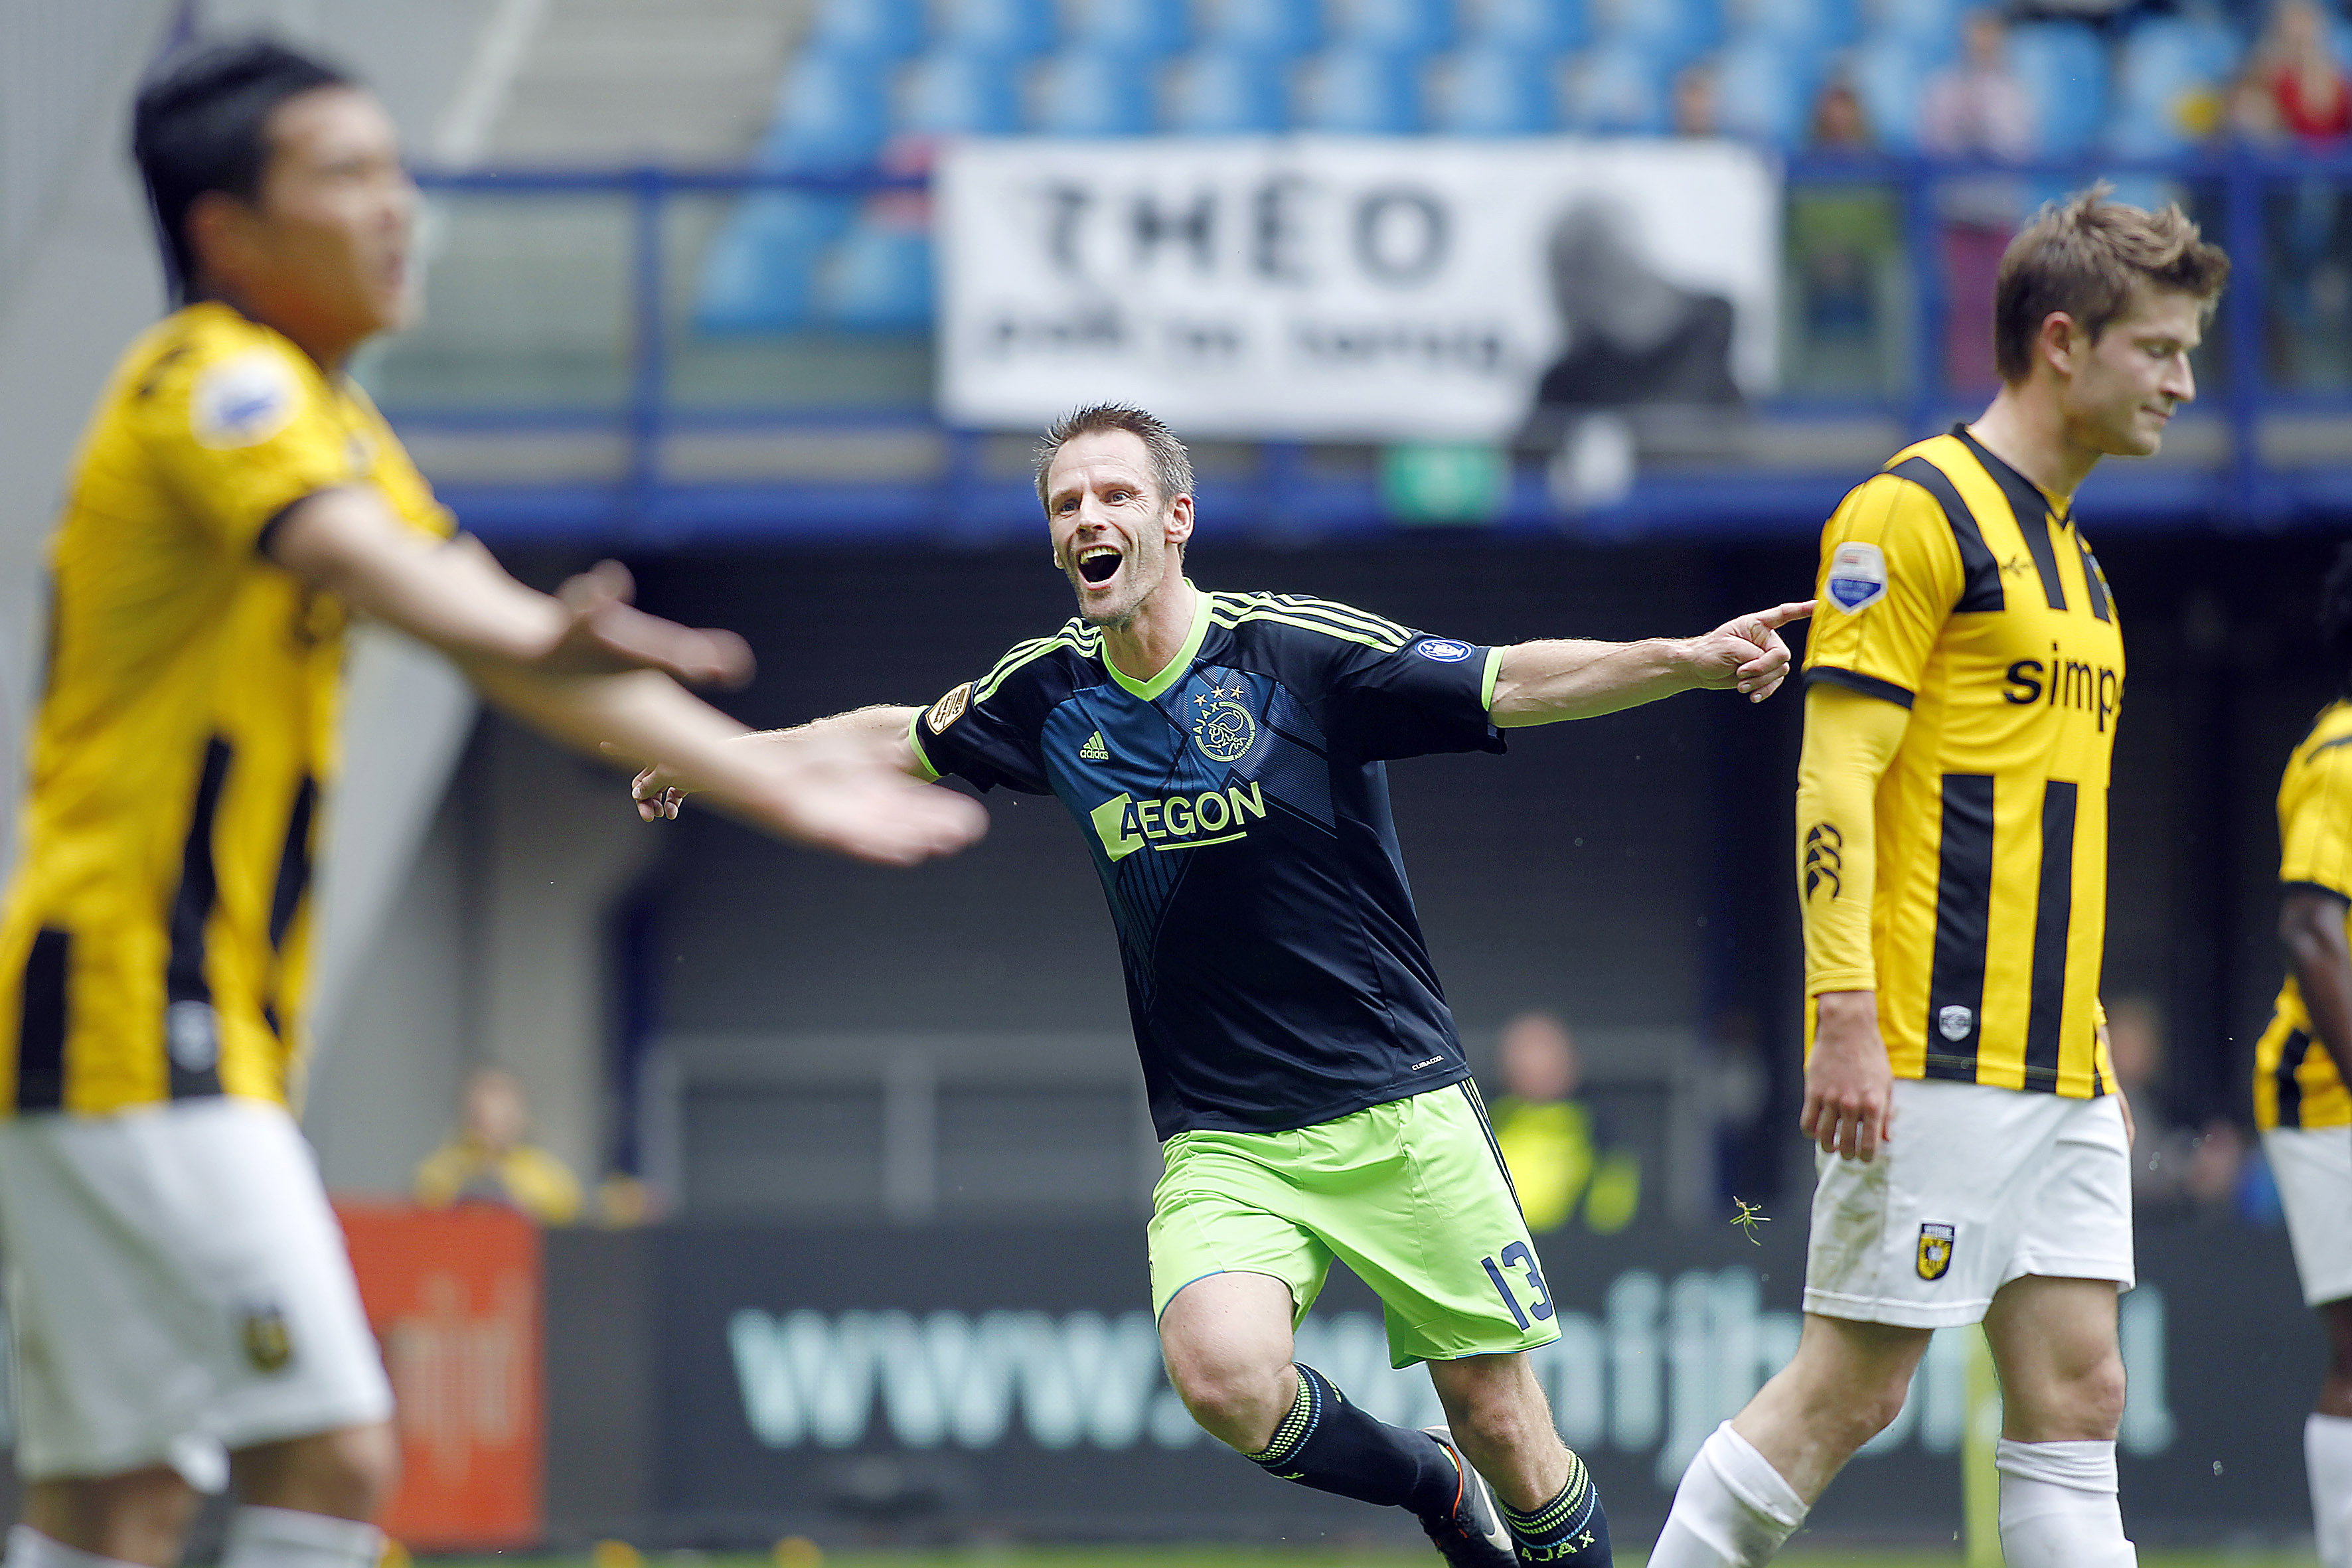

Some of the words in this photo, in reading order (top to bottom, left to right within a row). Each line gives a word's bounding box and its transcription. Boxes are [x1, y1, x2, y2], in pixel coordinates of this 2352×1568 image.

[2003, 642, 2119, 732] simp
[1192, 702, 1220, 736] AJAX
[1079, 748, 1109, 760] adidas
[1115, 781, 1267, 844] AEGON
[1480, 1241, 1553, 1331] 13
[1521, 1529, 1596, 1562] AJAX
